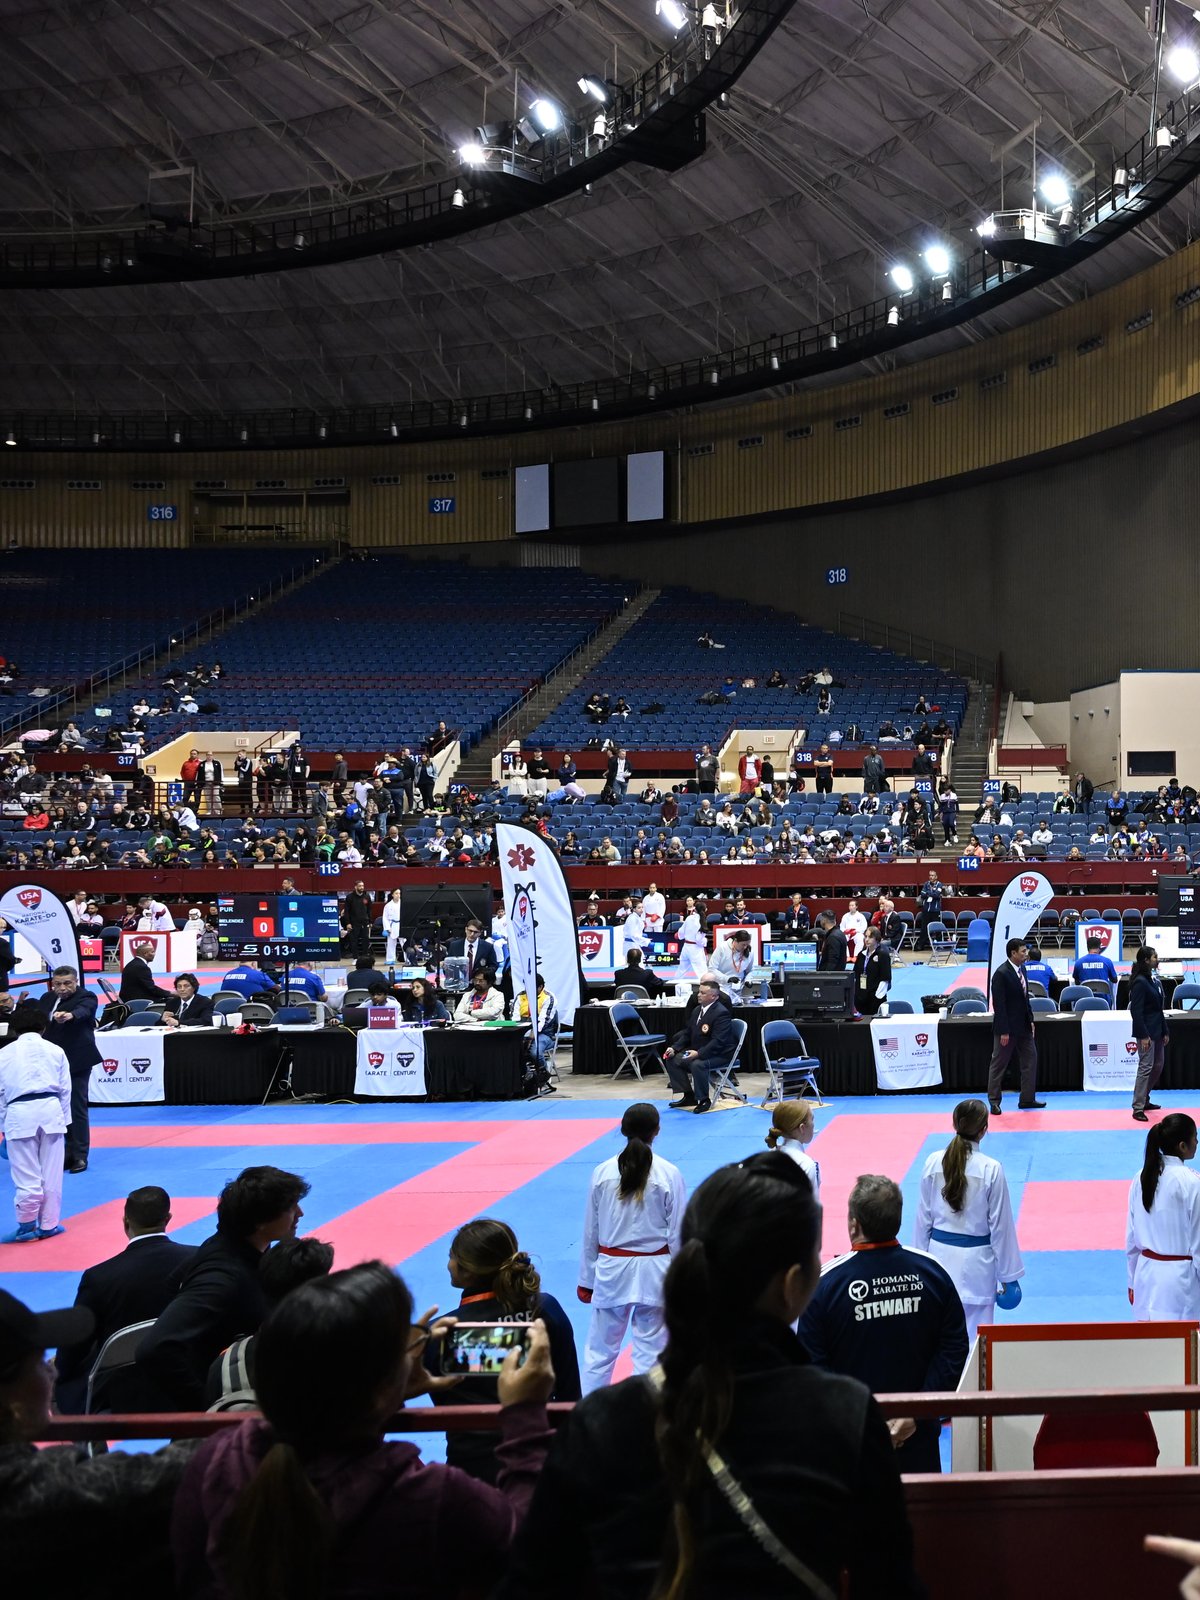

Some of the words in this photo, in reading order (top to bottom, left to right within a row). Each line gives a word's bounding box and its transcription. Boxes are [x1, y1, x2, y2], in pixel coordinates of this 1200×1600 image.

[433, 499, 452, 512] 317
[151, 506, 173, 519] 316
[828, 568, 847, 584] 318
[118, 755, 134, 765] 317
[796, 753, 812, 761] 318
[915, 782, 931, 791] 213
[983, 782, 999, 791] 214
[319, 863, 340, 874] 113
[959, 858, 978, 868] 114
[1022, 878, 1036, 887] USA
[20, 891, 40, 900] USA
[1008, 899, 1042, 909] KARATE-DO
[14, 912, 57, 925] KARATE-DO
[259, 922, 268, 933] 0
[290, 922, 298, 933] 5
[1004, 925, 1010, 940] 1
[1088, 929, 1109, 939] USA
[578, 935, 600, 945] USA
[51, 938, 62, 954] 3
[83, 947, 94, 956] 00
[263, 945, 295, 956] 0:13.0
[872, 1273, 920, 1286] HOMANN
[873, 1283, 909, 1295] KARATE
[854, 1296, 921, 1322] STEWART
